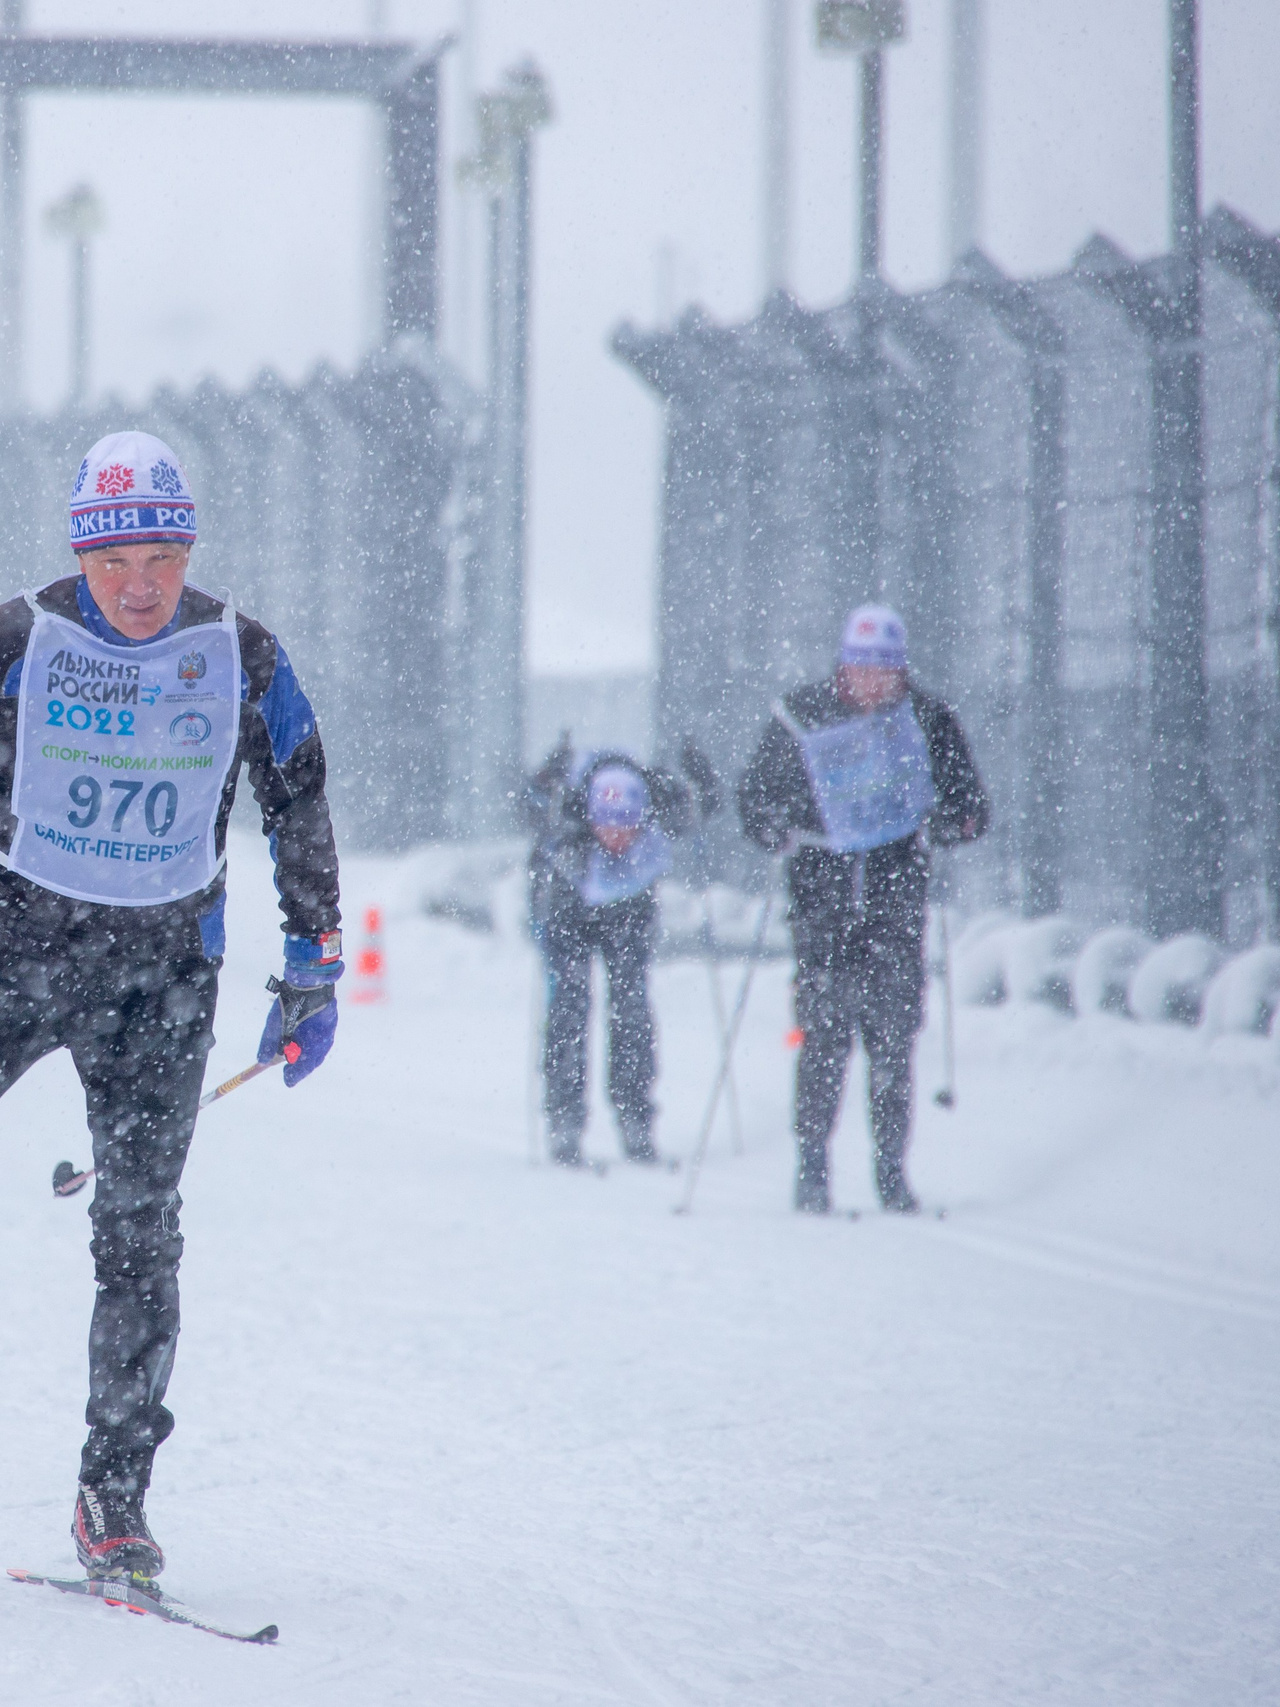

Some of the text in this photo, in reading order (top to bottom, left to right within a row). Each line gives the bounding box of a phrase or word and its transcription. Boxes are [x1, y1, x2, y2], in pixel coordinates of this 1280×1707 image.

[70, 508, 140, 537] ЫЖНЯ
[47, 650, 140, 680] ЛЫЖНЯ
[47, 672, 139, 705] РОССИИ
[45, 699, 135, 736] 2022
[41, 744, 214, 771] СПОРТ НОРМА ЖИЗНИ
[66, 774, 179, 837] 970
[34, 823, 199, 863] САНКТ-ПЕТЕРБУРГ
